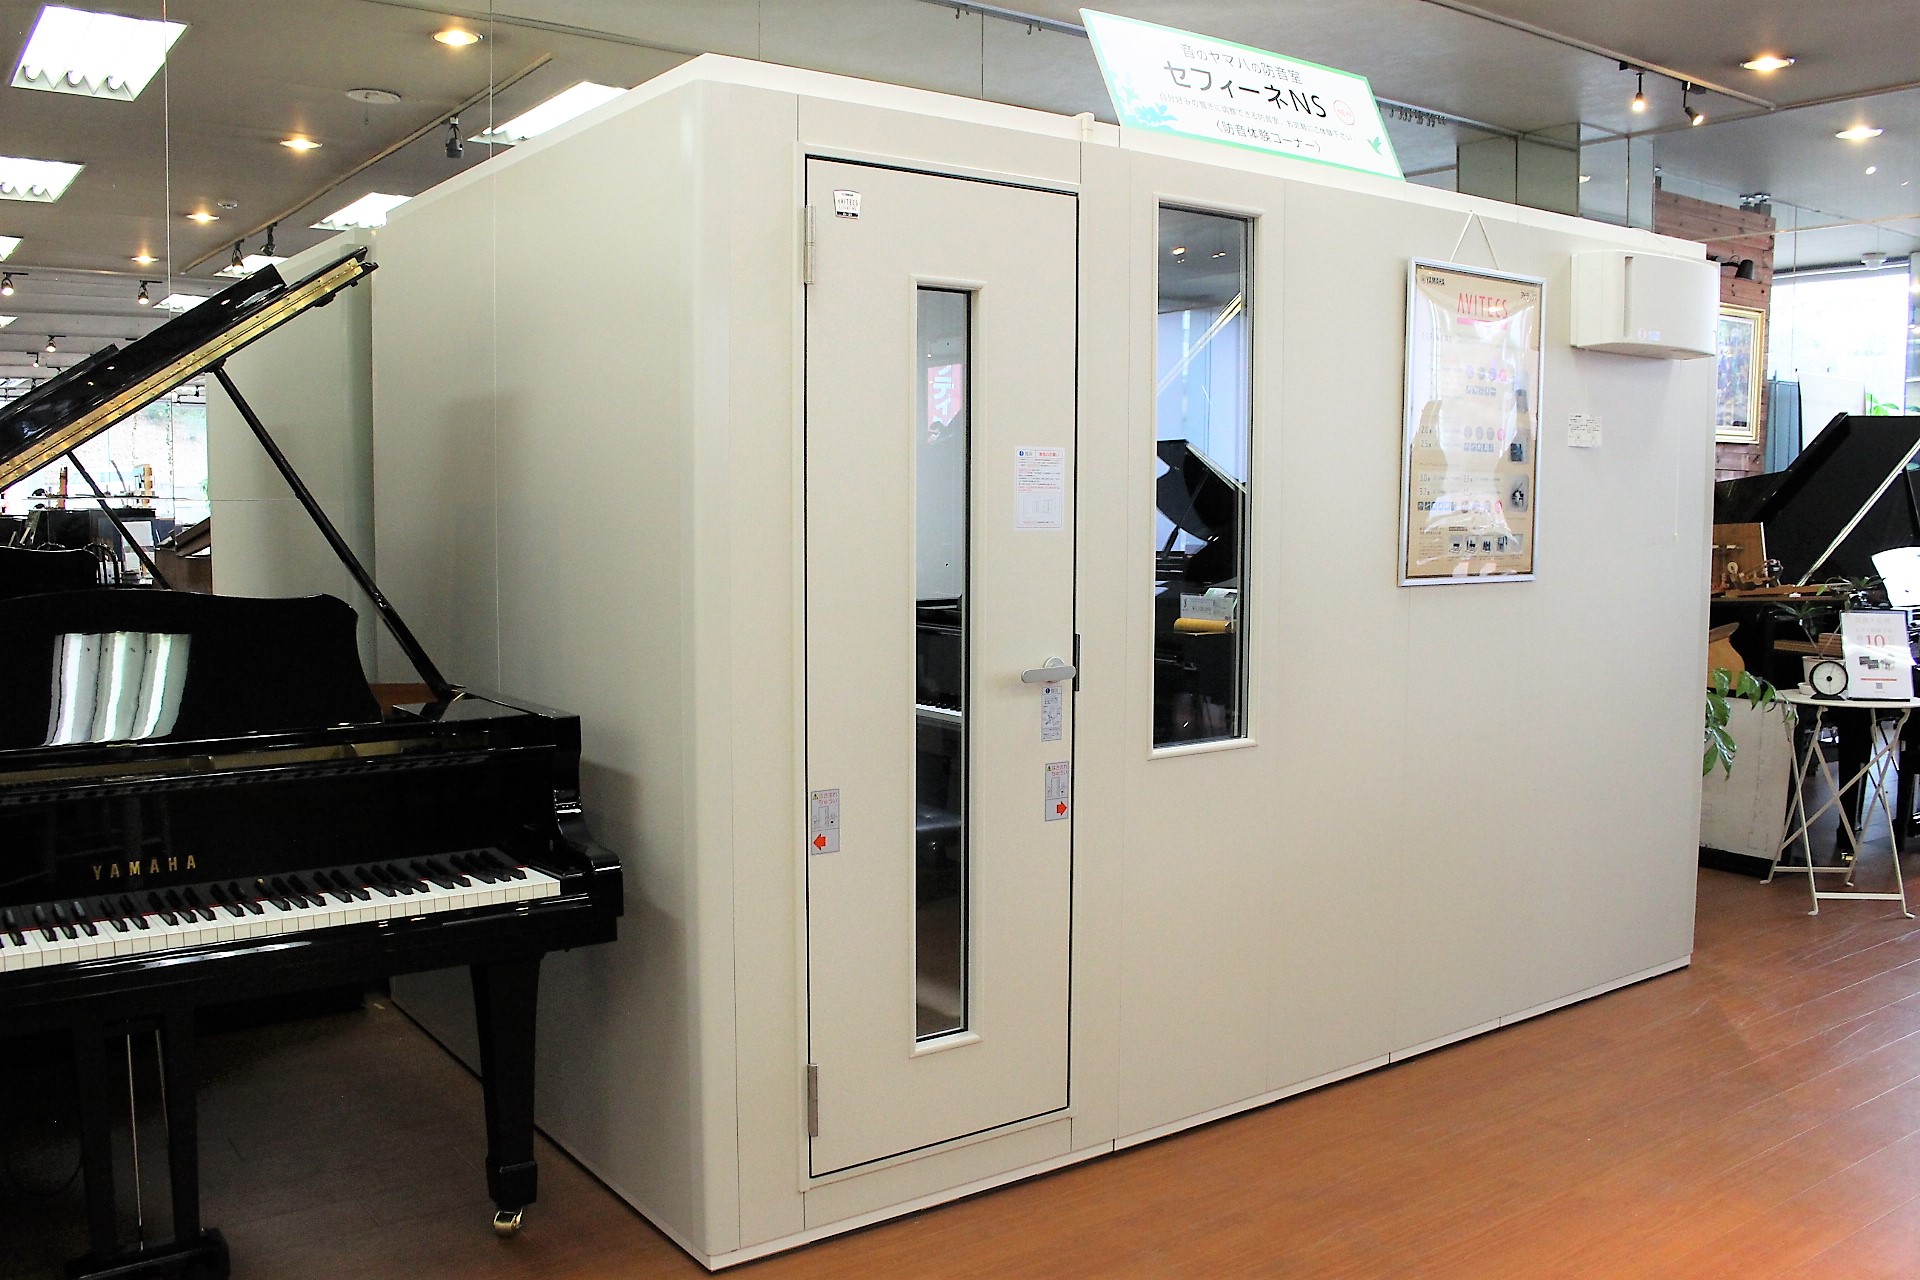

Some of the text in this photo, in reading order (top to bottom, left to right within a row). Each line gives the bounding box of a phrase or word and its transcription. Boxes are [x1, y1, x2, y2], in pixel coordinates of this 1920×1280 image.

[1180, 43, 1303, 85] 音のヤマハの防音室
[1163, 60, 1327, 118] セフィーネNS
[1426, 275, 1445, 286] YAMAHA
[1457, 291, 1508, 319] AVITECS
[1866, 634, 1886, 648] 10
[93, 854, 197, 880] YAMAHA
